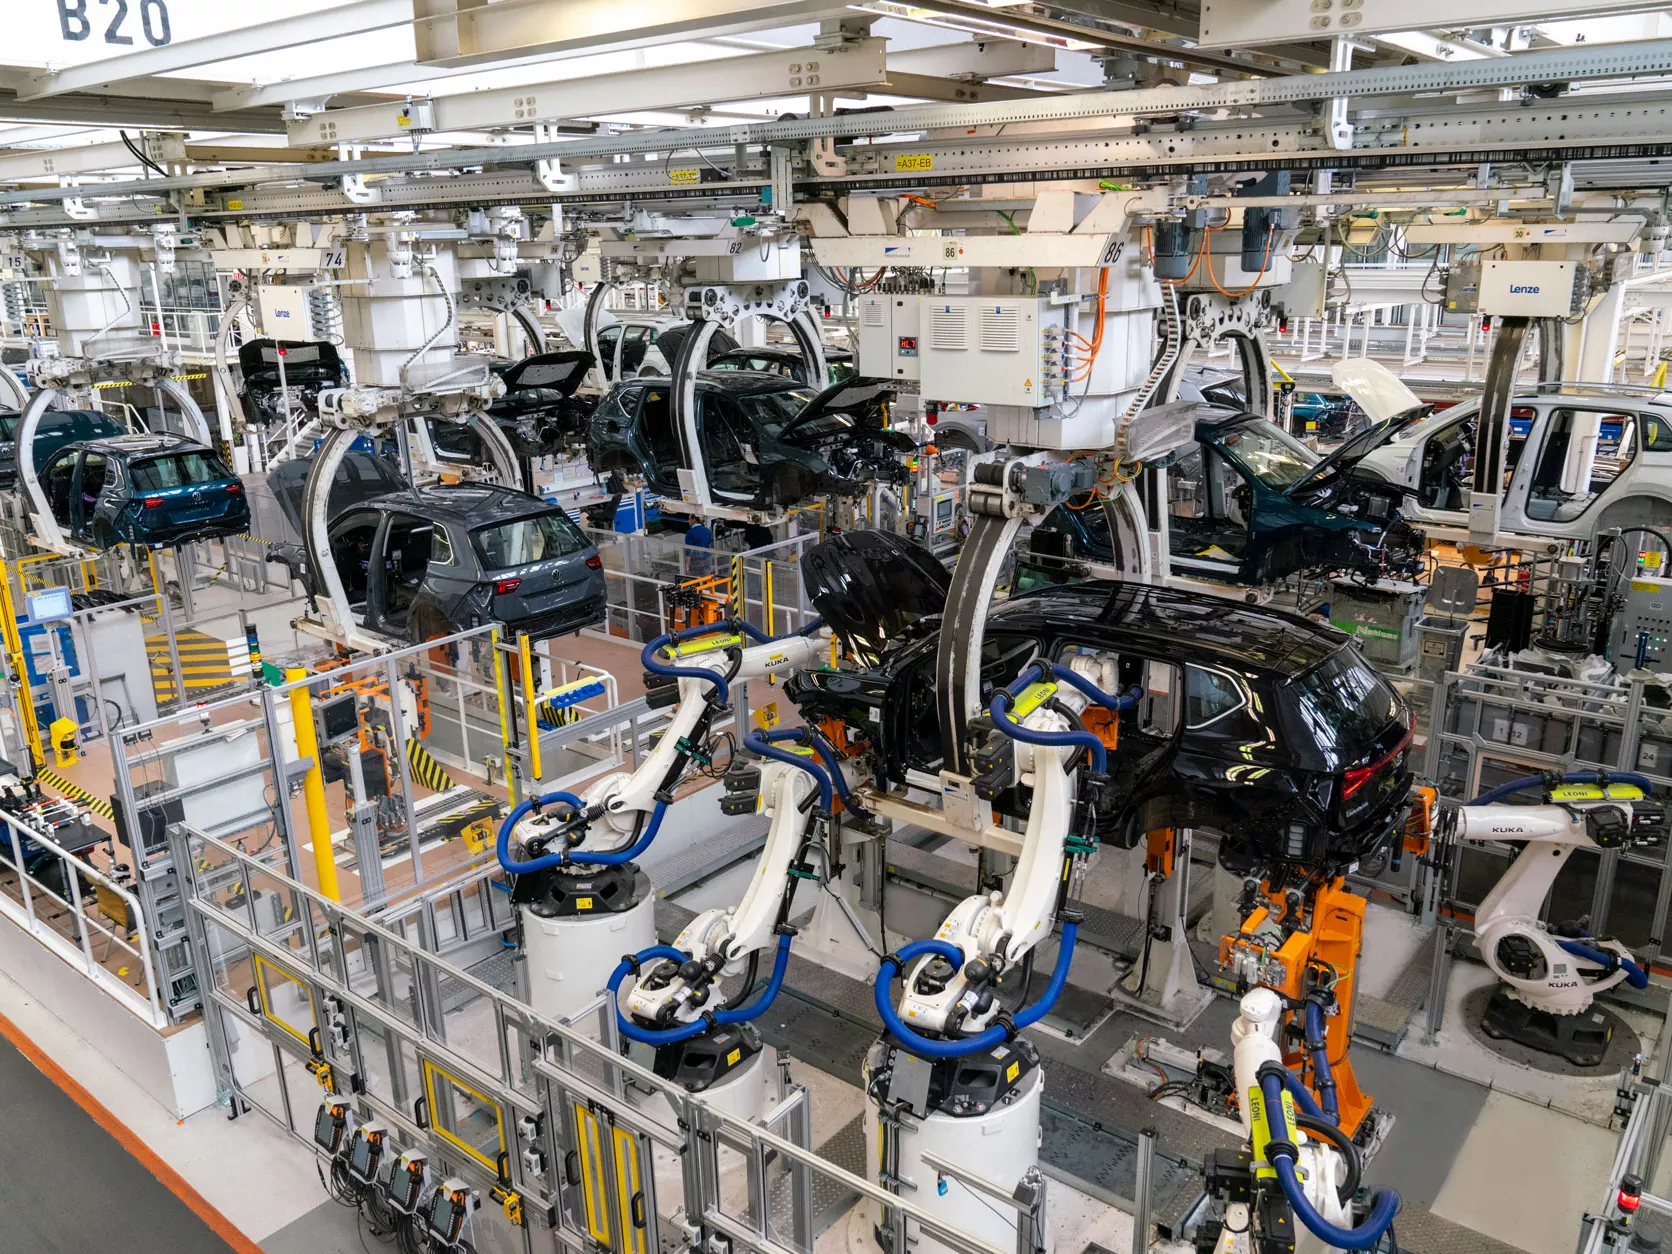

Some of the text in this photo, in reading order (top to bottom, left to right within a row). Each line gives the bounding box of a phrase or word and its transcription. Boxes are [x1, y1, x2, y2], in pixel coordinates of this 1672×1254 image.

[58, 0, 172, 46] B20
[897, 158, 932, 168] =A37-EB
[730, 242, 742, 254] 82
[945, 247, 955, 258] 86
[1104, 241, 1125, 264] 86
[9, 256, 22, 267] 15
[326, 252, 342, 267] 74
[1510, 284, 1540, 294] Lenze
[711, 637, 732, 646] LEONI
[765, 657, 789, 668] KUKA
[1034, 687, 1051, 700] LEONI
[1642, 752, 1654, 761] 24
[1251, 1097, 1262, 1122] LEONI
[1285, 1100, 1296, 1126] LEONI
